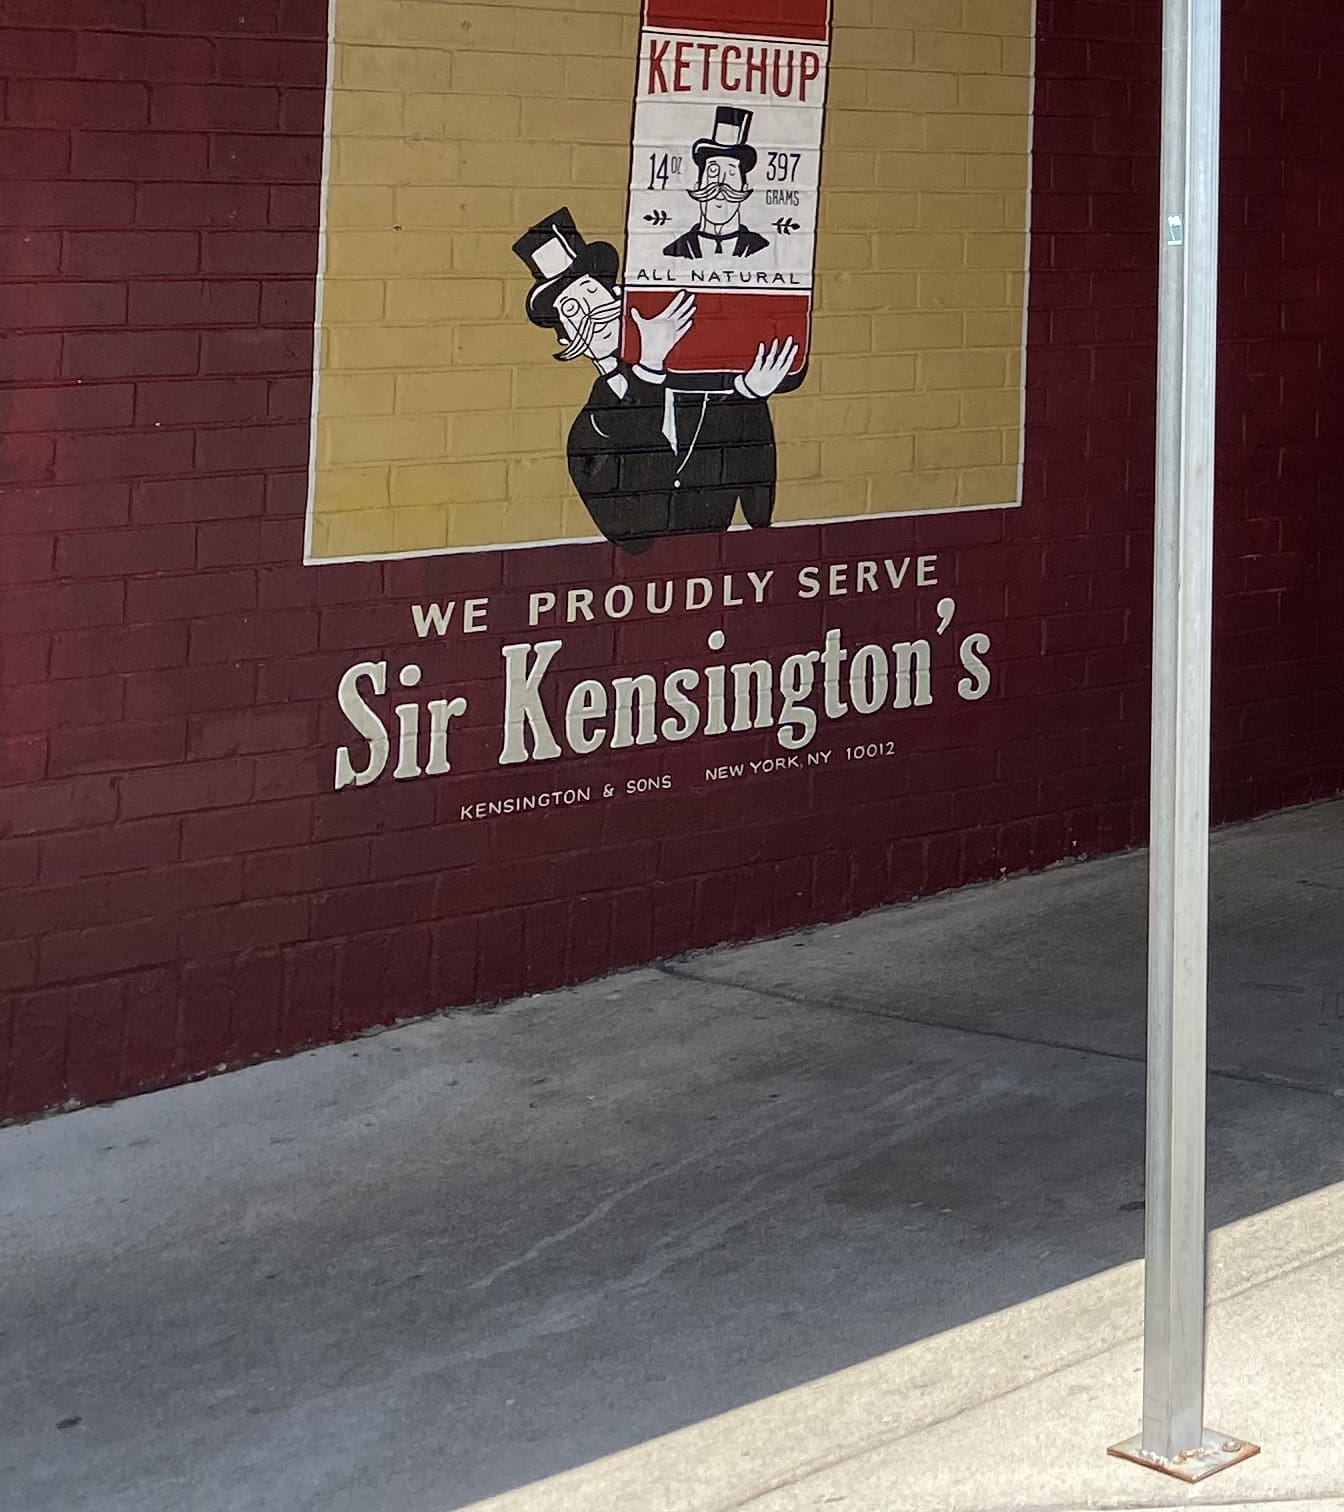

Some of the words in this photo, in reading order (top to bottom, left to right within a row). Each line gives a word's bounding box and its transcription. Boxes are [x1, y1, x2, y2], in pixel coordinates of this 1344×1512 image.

[648, 39, 820, 102] KETCHUP
[765, 189, 800, 206] GRAMS
[766, 151, 801, 182] 397
[637, 268, 676, 282] ALL
[691, 269, 801, 285] NATURAL
[411, 597, 489, 638] WE
[528, 570, 775, 626] PROUDLY
[798, 555, 939, 599] SERVE
[334, 660, 467, 790] Sir
[498, 597, 992, 765] Kensington's
[460, 787, 591, 821] KENSINGTON
[602, 784, 615, 799] &
[626, 776, 672, 796] SONS
[705, 764, 744, 782] NEW
[808, 750, 832, 766] NY
[845, 741, 896, 761] 10012
